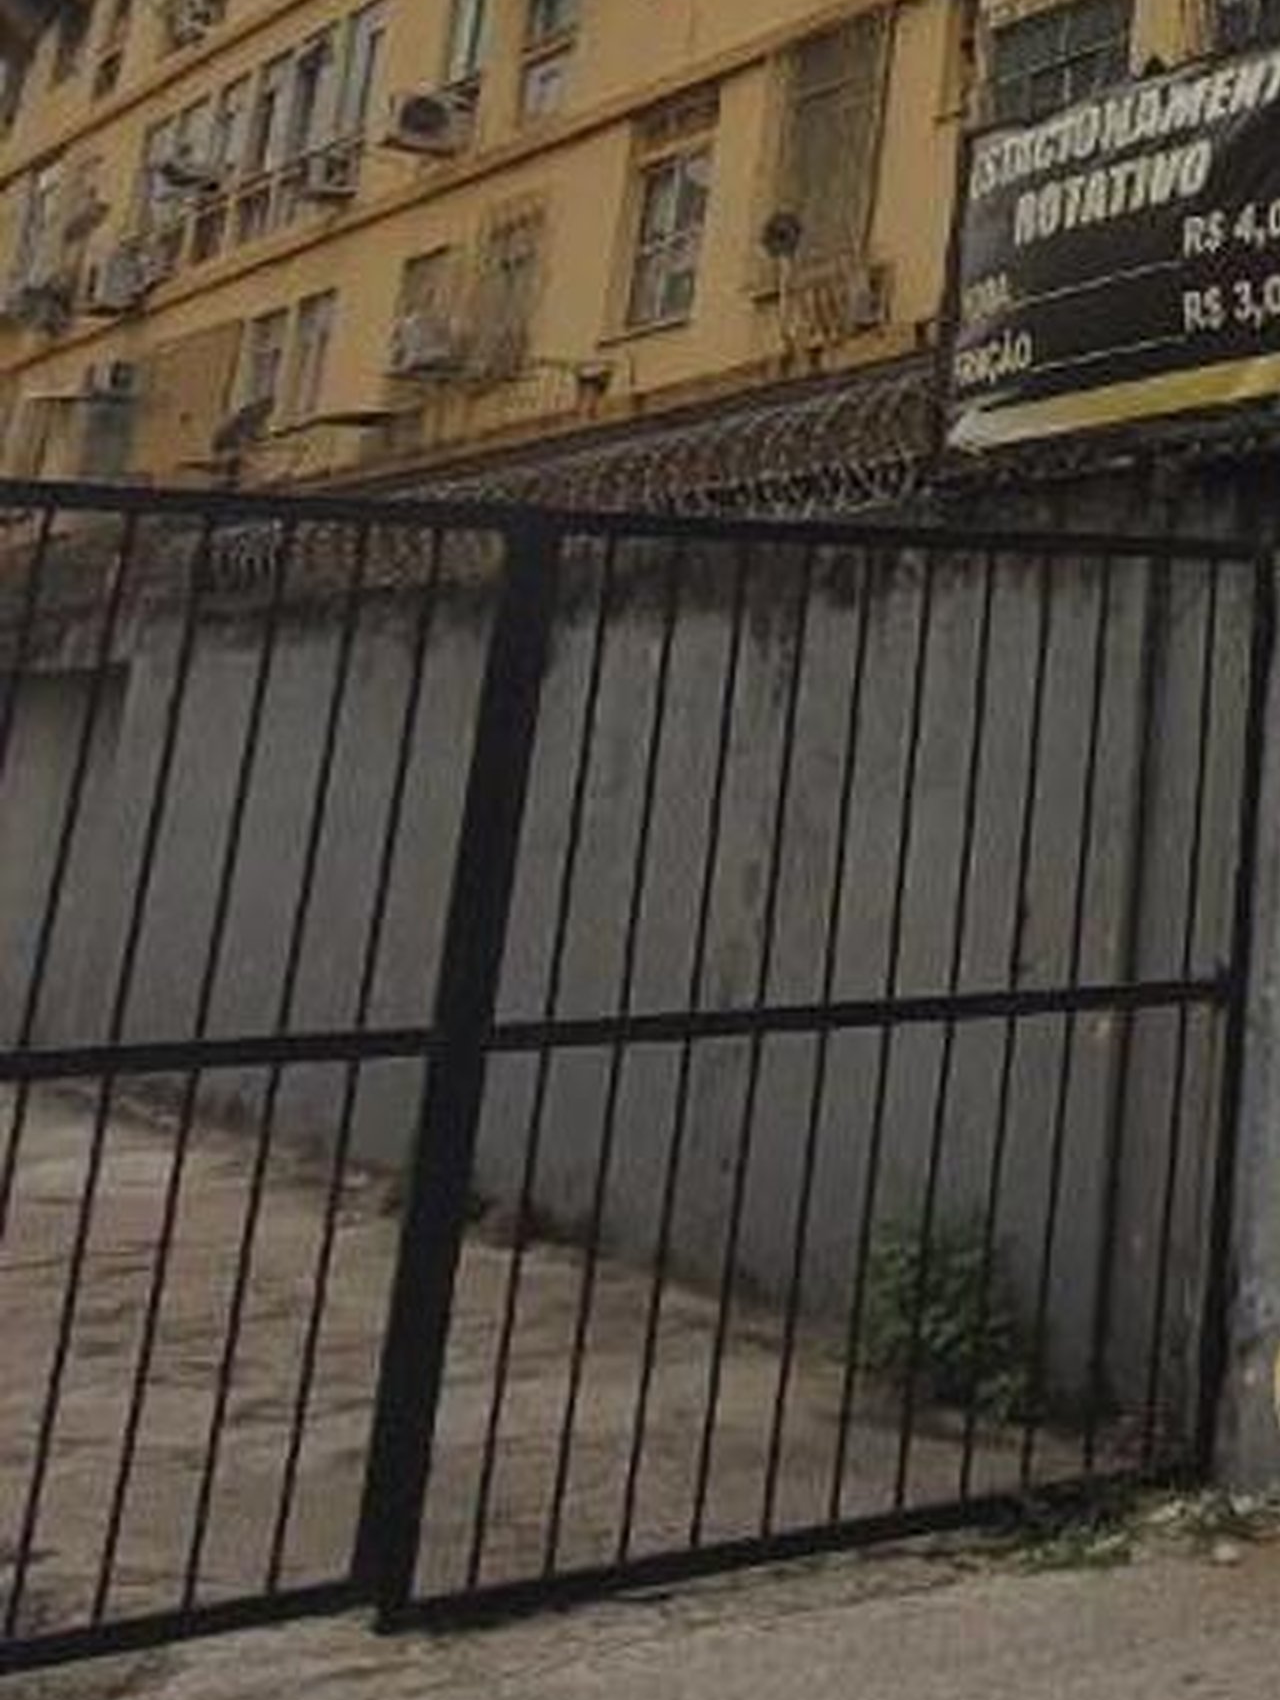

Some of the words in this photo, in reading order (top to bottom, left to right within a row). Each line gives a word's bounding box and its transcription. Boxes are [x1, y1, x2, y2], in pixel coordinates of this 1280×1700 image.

[1014, 139, 1213, 248] ROTATIVO
[1183, 215, 1224, 258] R$
[1183, 287, 1224, 332] R$
